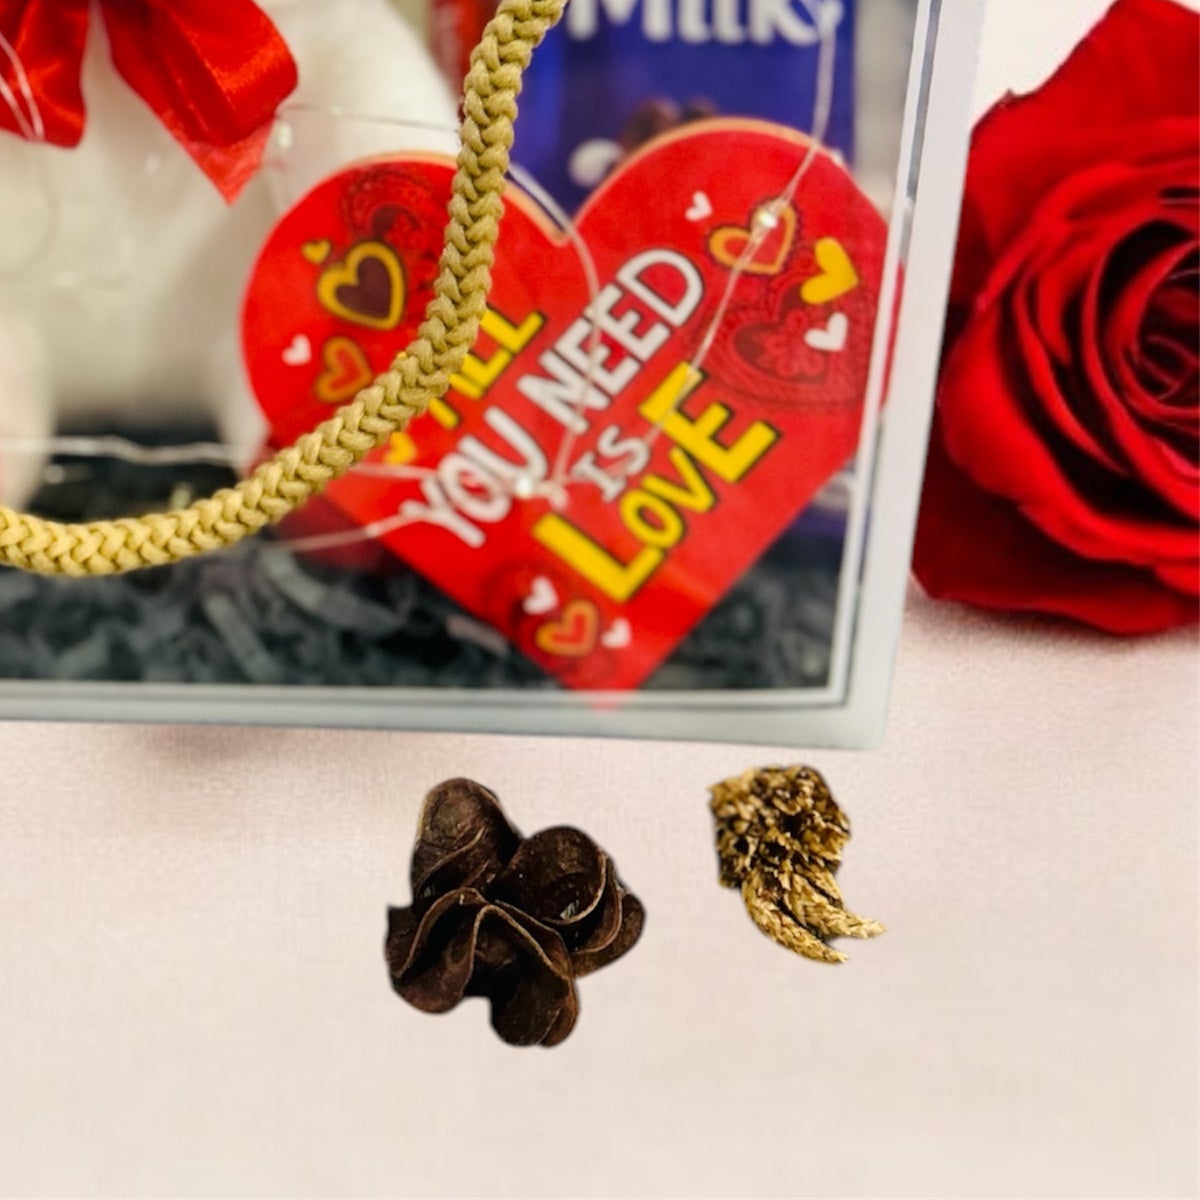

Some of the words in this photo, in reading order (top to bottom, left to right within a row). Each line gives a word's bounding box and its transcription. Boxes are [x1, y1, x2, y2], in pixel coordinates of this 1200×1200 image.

[398, 405, 548, 548] YOU
[515, 248, 704, 435] NEED
[533, 360, 780, 603] LOVE
[571, 424, 650, 503] IS
